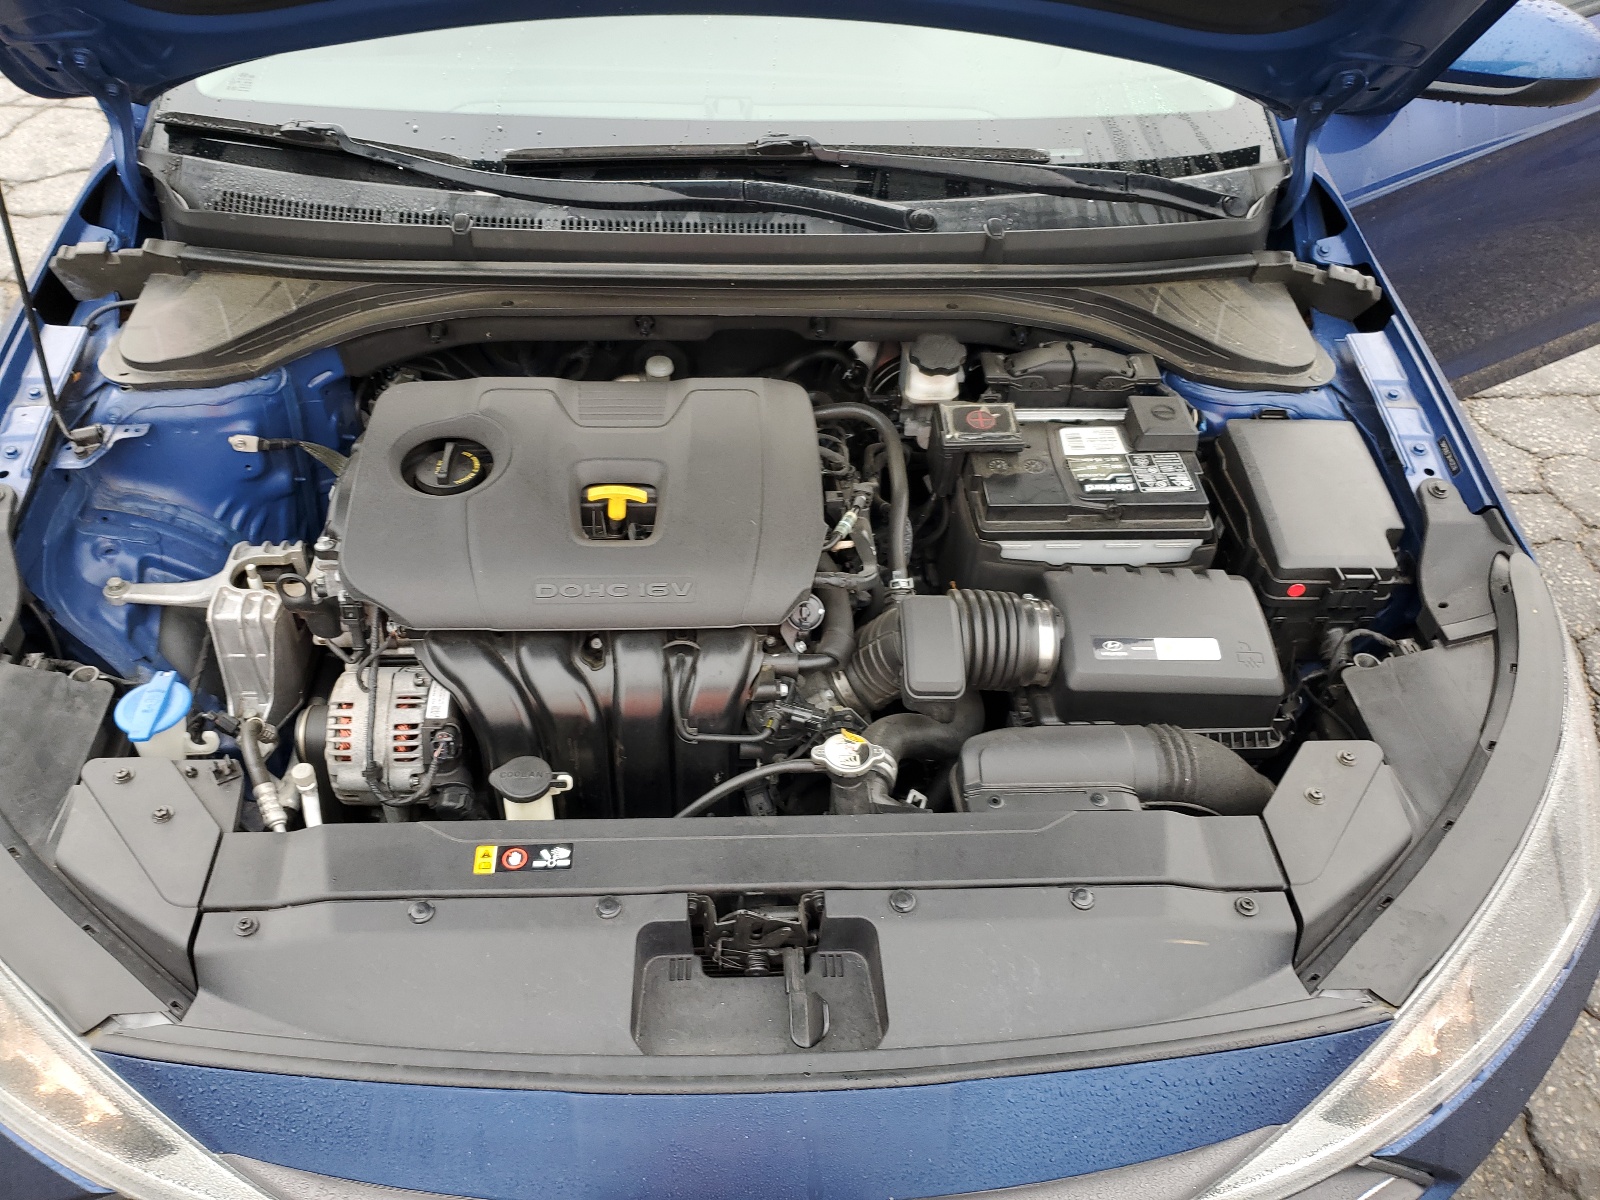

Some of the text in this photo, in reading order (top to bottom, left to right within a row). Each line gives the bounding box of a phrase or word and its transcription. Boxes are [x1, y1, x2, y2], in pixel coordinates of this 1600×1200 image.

[1085, 483, 1135, 492] DieHard
[535, 582, 693, 599] DOHC 16V
[499, 771, 552, 779] COOLANT
